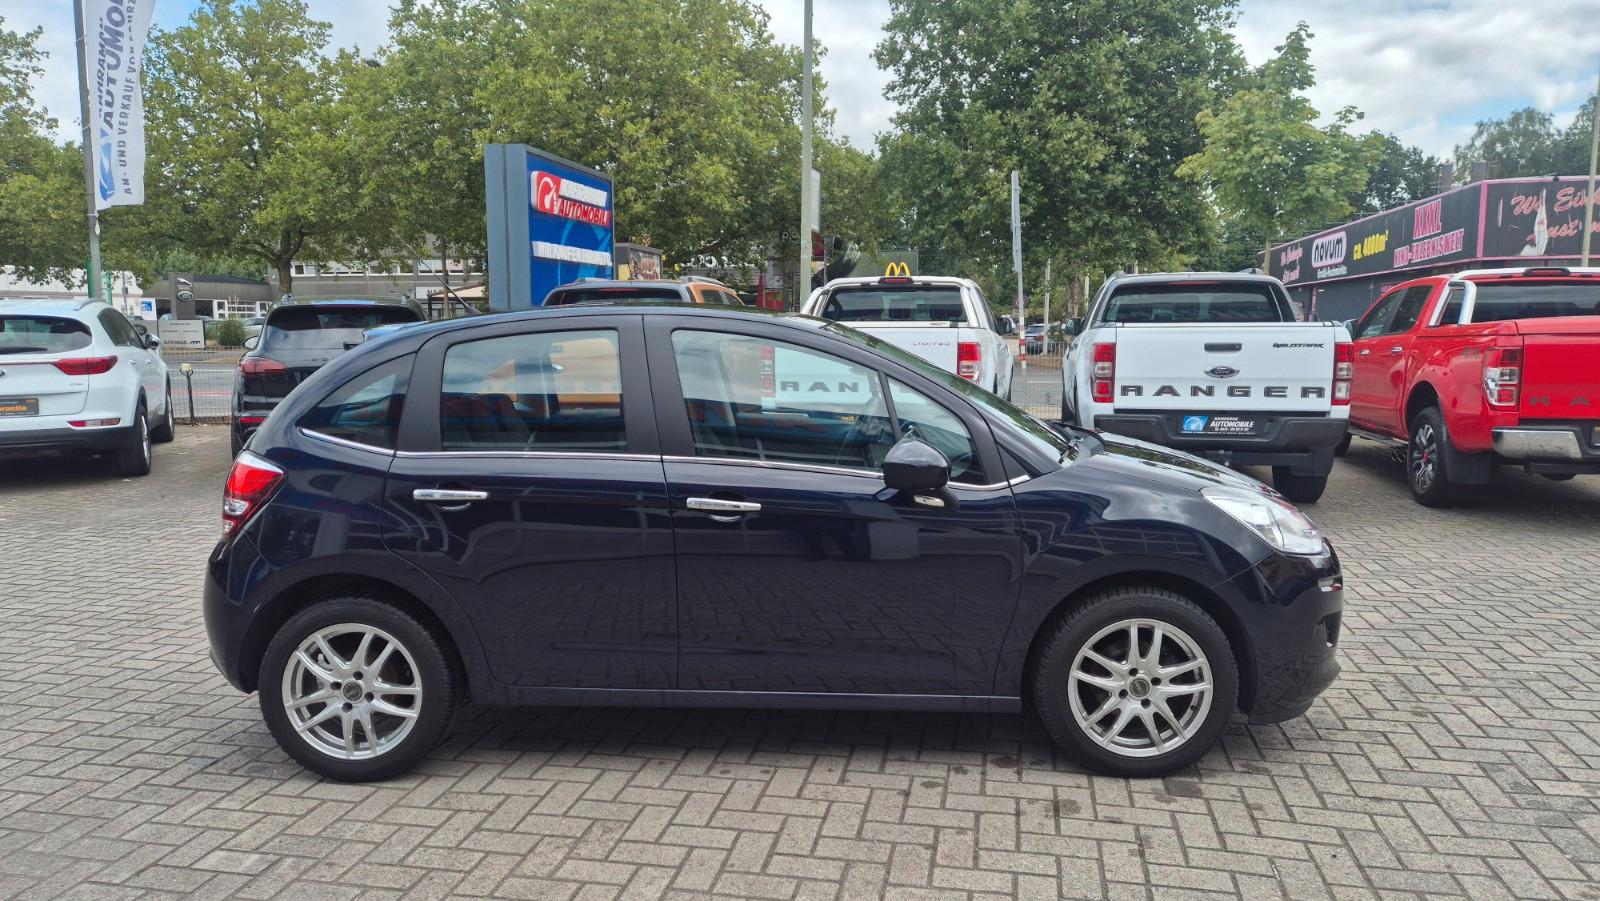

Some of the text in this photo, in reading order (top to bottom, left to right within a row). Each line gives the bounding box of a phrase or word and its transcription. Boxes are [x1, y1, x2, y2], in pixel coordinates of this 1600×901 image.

[118, 77, 135, 135] VERKAUF
[117, 140, 127, 167] UND
[1413, 199, 1442, 240] XXXL
[1314, 237, 1343, 263] novum
[1120, 385, 1326, 398] RANGER
[1210, 420, 1255, 428] AUTOMOBILE
